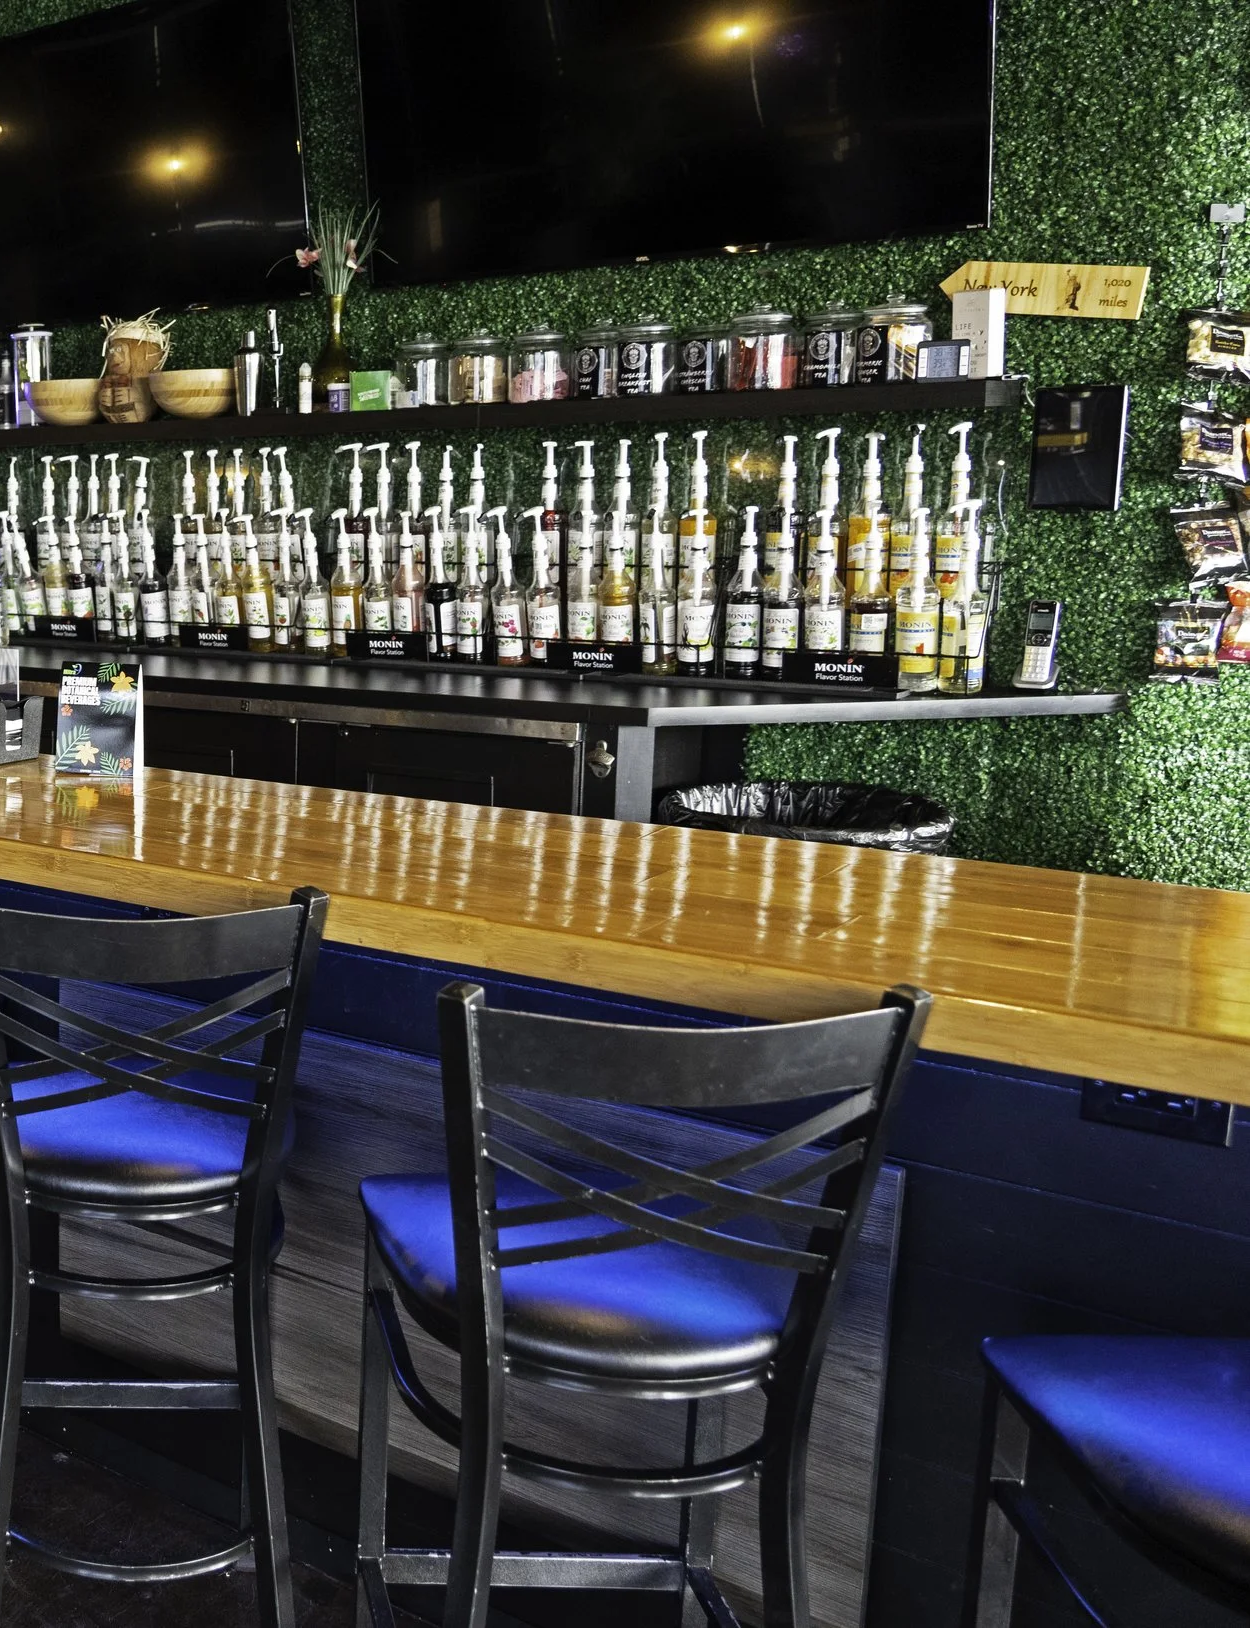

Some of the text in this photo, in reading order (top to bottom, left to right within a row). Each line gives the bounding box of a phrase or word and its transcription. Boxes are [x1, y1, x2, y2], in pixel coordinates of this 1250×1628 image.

[1104, 278, 1132, 288] 1,020
[1098, 296, 1129, 308] miles
[955, 323, 971, 331] LIFE
[51, 623, 76, 631] MONIN
[369, 641, 404, 649] MONIN
[572, 652, 613, 661] MONIN
[593, 661, 614, 669] Station
[814, 663, 863, 673] MONIN
[62, 676, 97, 687] PREMIUM
[815, 673, 864, 682] Flavor Station
[61, 685, 99, 696] BOTANICAL
[60, 694, 101, 706] BEVERAGES
